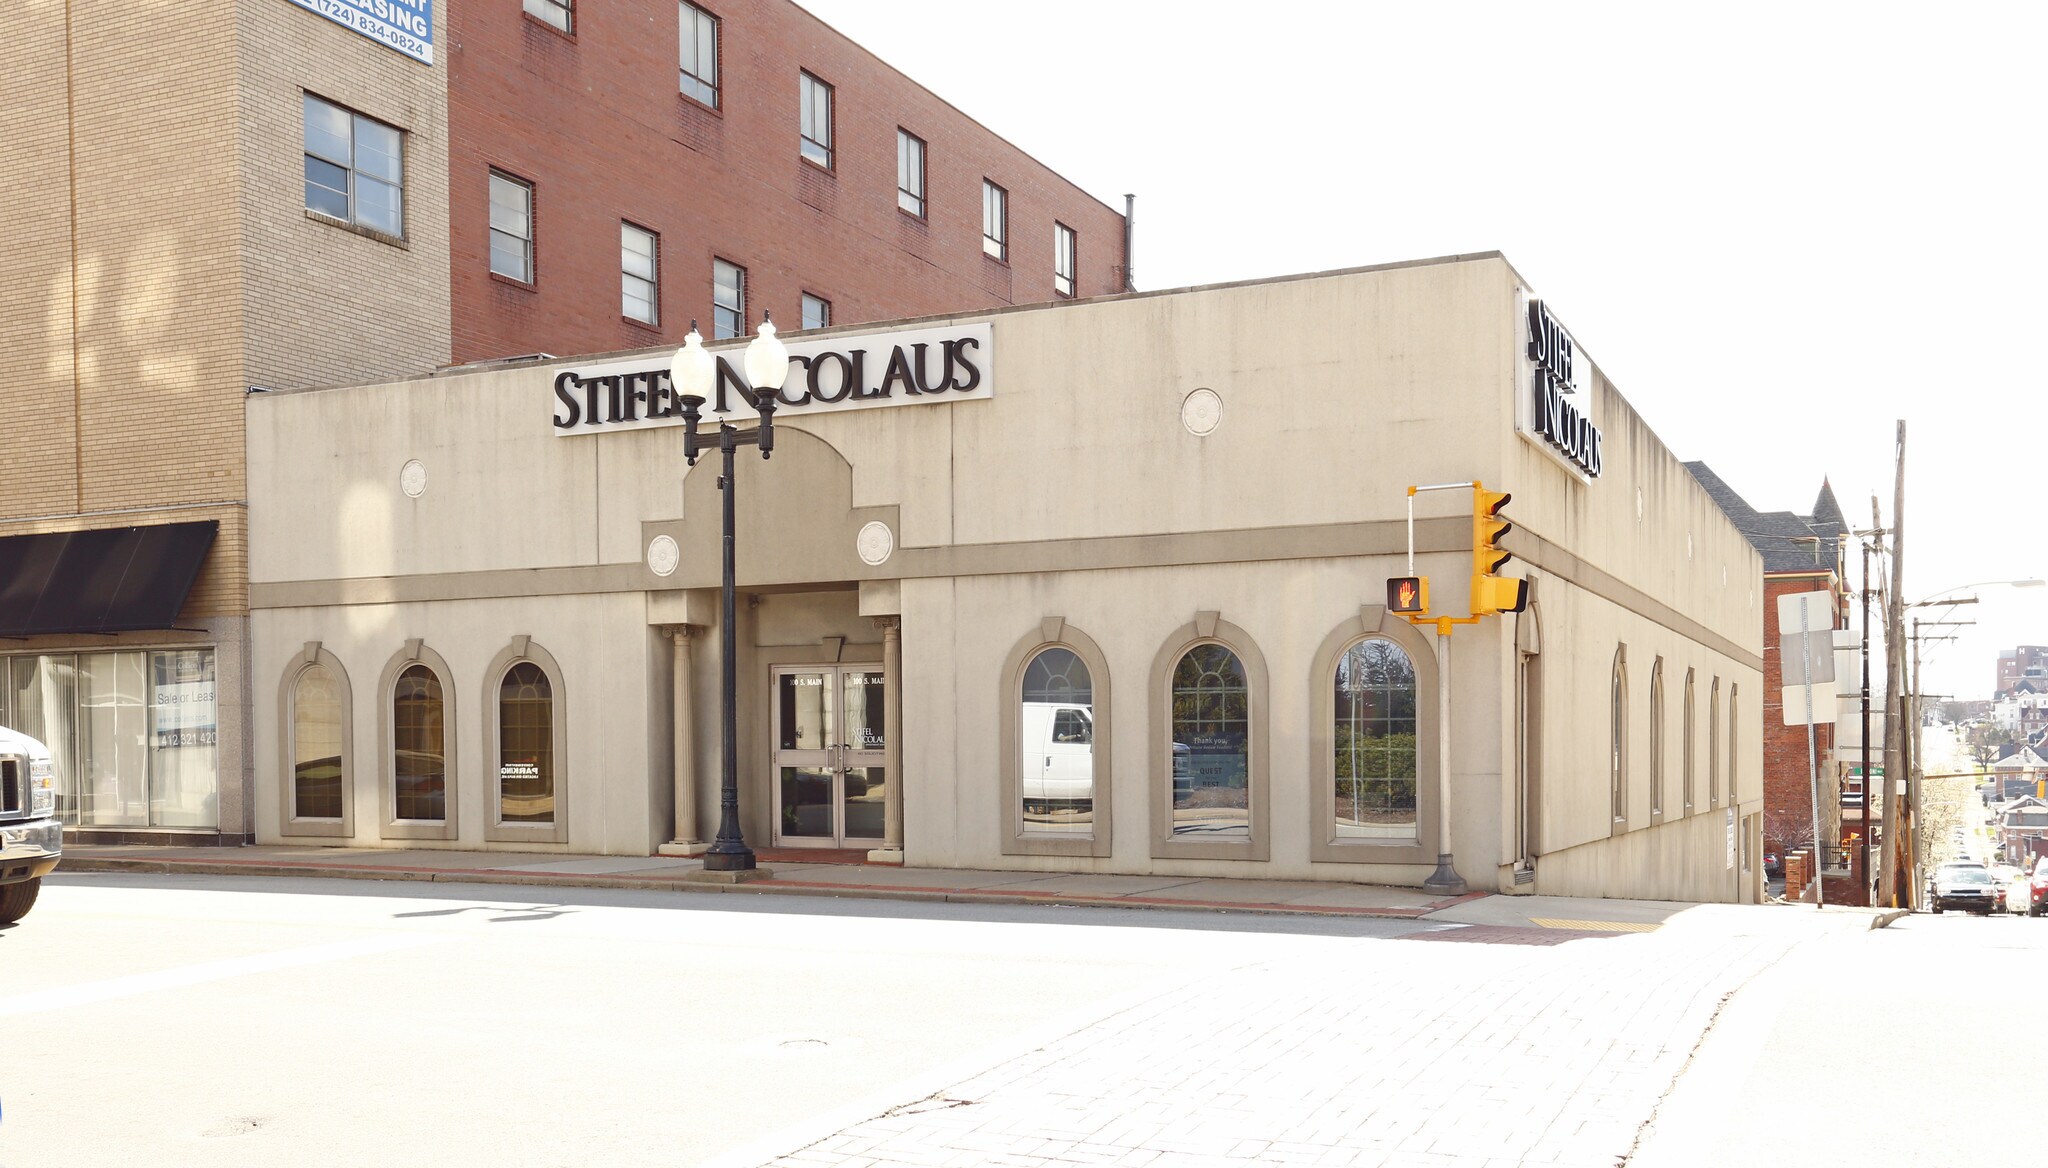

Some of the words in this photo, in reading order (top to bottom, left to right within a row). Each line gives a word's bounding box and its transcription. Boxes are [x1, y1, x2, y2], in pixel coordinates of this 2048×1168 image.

[317, 0, 355, 25] (724)
[359, 16, 424, 56] 834-0824
[349, 0, 427, 37] ASING
[1527, 298, 1577, 395] STIFEL
[712, 337, 980, 413] NCOLAUS
[1534, 368, 1603, 479] NICOLAUS
[157, 693, 178, 705] Sale
[180, 693, 189, 703] or
[191, 691, 216, 702] Leas
[161, 734, 179, 746] 412
[181, 733, 197, 745] 321
[1199, 767, 1223, 775] QUEST
